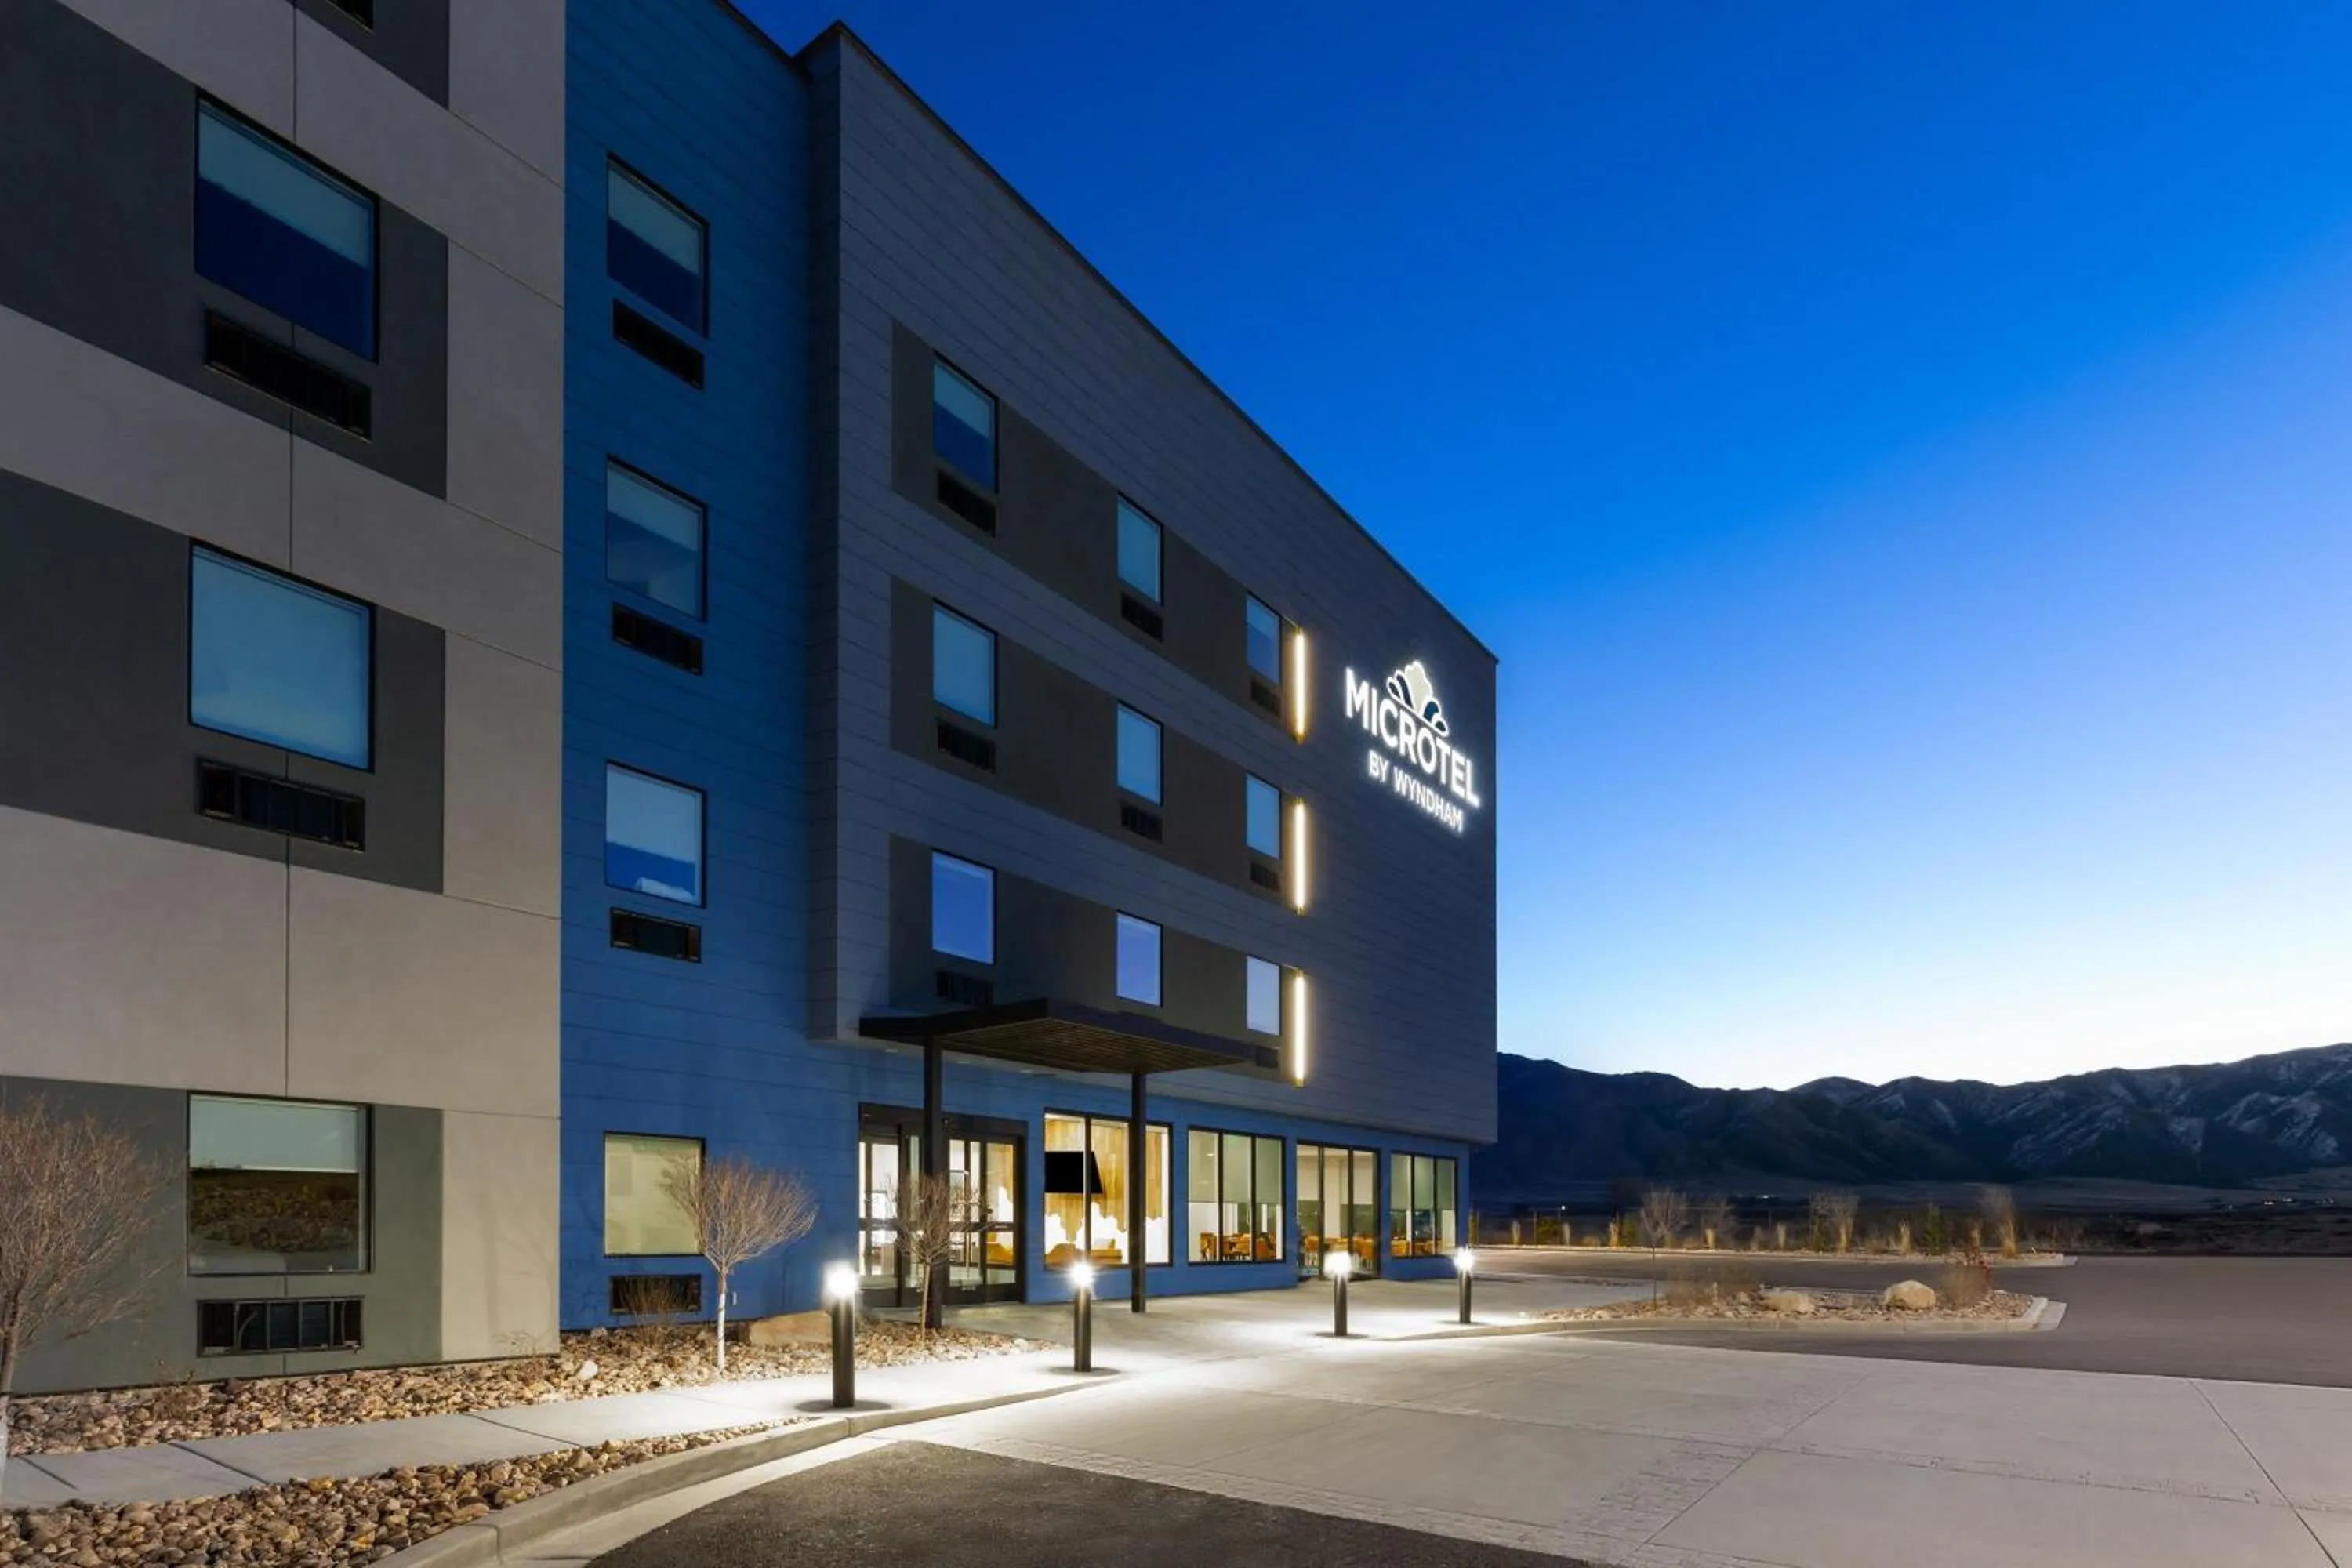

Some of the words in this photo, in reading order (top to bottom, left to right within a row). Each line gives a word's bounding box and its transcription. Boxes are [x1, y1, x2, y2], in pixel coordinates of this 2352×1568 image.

[1345, 666, 1480, 808] MICROTEL
[1369, 750, 1389, 782] BY
[1393, 766, 1464, 832] WYNDHAM
